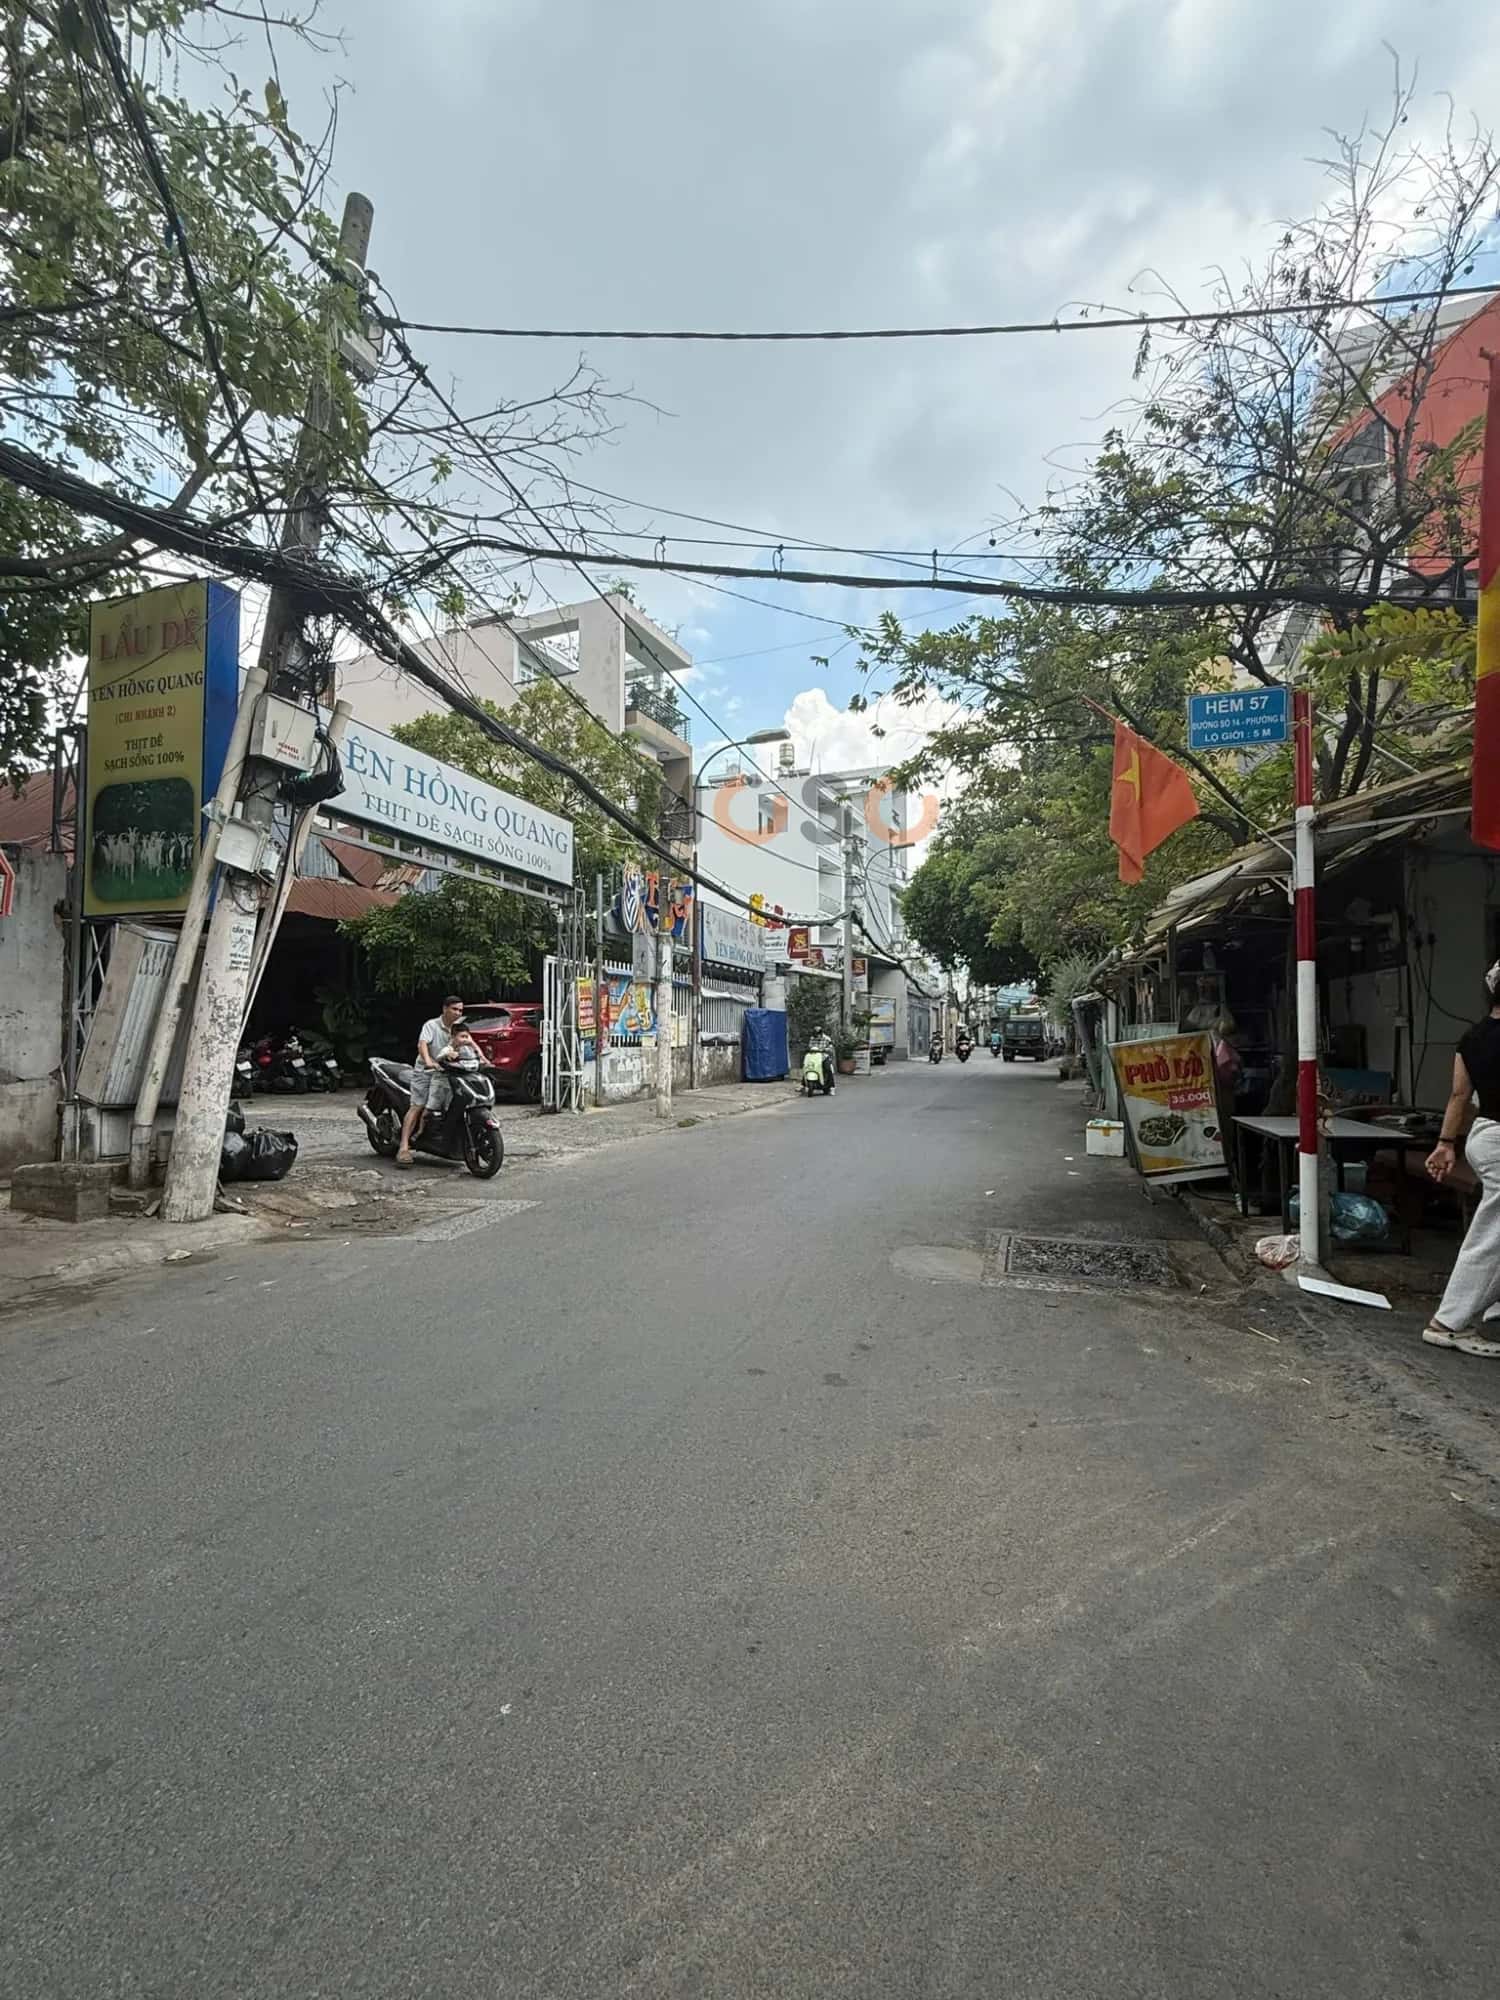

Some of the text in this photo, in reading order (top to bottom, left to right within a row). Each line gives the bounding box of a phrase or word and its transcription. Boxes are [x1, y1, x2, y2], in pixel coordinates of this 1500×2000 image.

[119, 678, 154, 698] HỒNG
[158, 671, 203, 695] QUANG
[1249, 696, 1269, 710] 57
[125, 732, 163, 752] THỊT DÊ
[1262, 728, 1271, 736] M
[104, 751, 184, 772] SẠCH SỐNG 100%
[403, 766, 488, 822] HỒNG
[495, 805, 569, 854] QUANG
[362, 791, 551, 871] THỊT DÊ SẠCH SỐNG 100%
